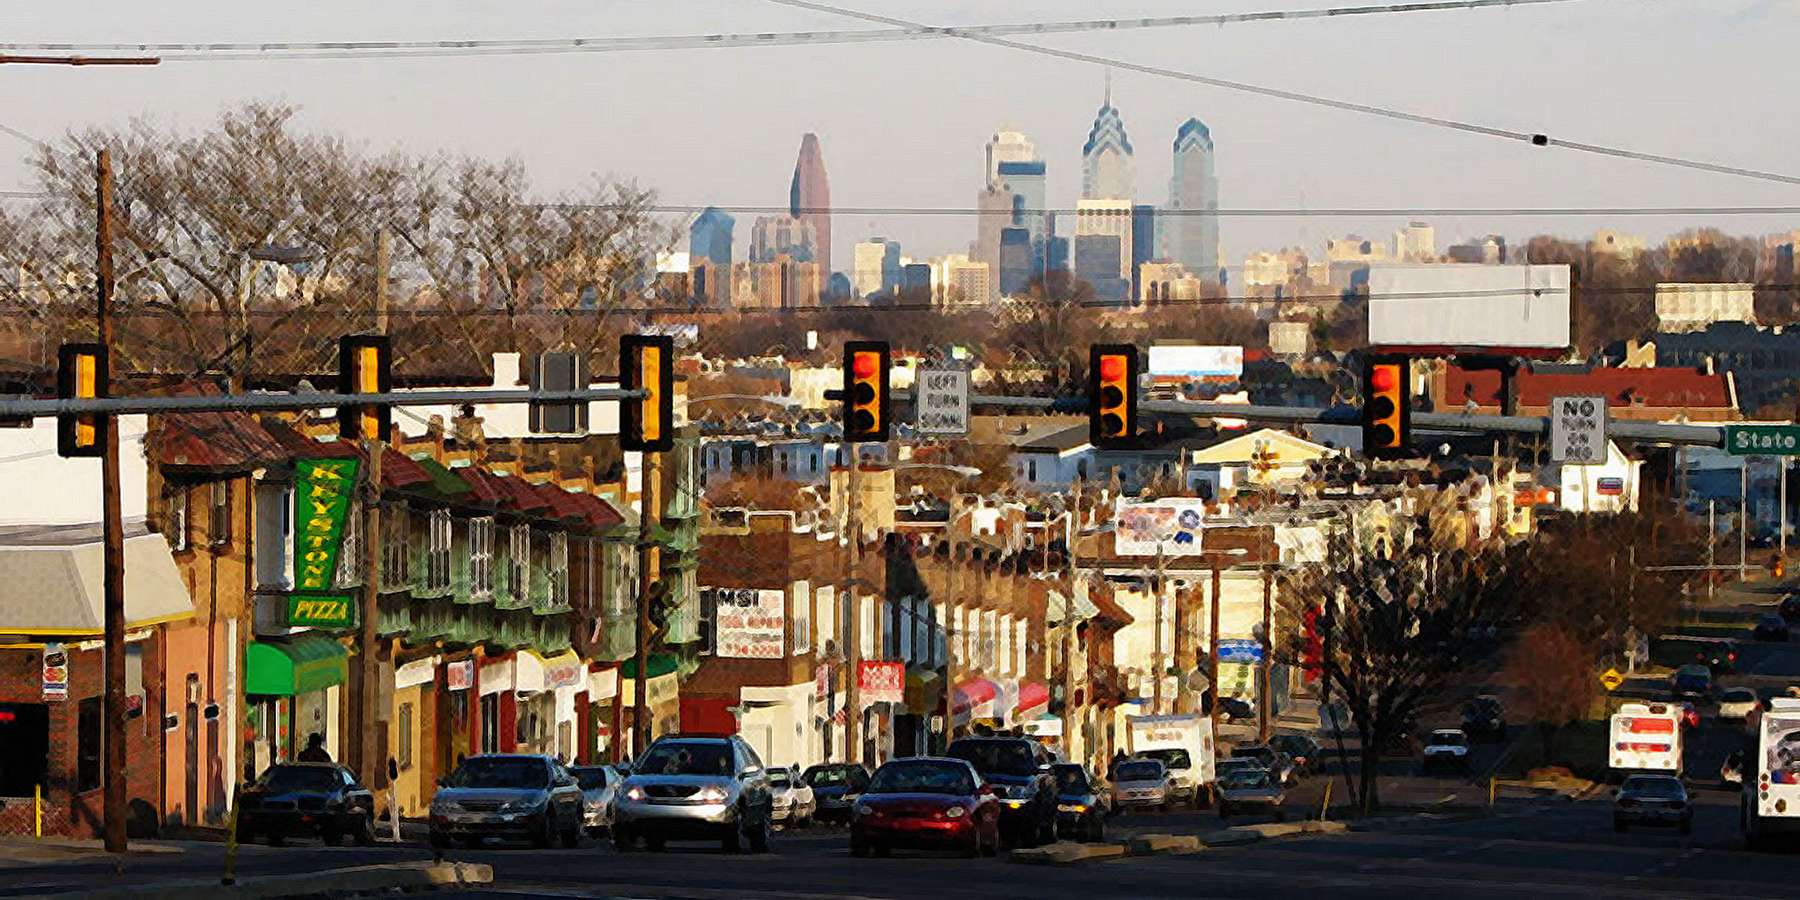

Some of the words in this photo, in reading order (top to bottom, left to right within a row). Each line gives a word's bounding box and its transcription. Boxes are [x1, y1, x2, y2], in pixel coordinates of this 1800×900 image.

[1563, 400, 1595, 417] NO
[1568, 432, 1589, 446] ON
[1736, 431, 1796, 448] State
[1565, 446, 1593, 460] RED
[303, 463, 345, 588] KEYSTONE
[719, 589, 759, 607] MSI
[294, 599, 348, 620] PIZZA
